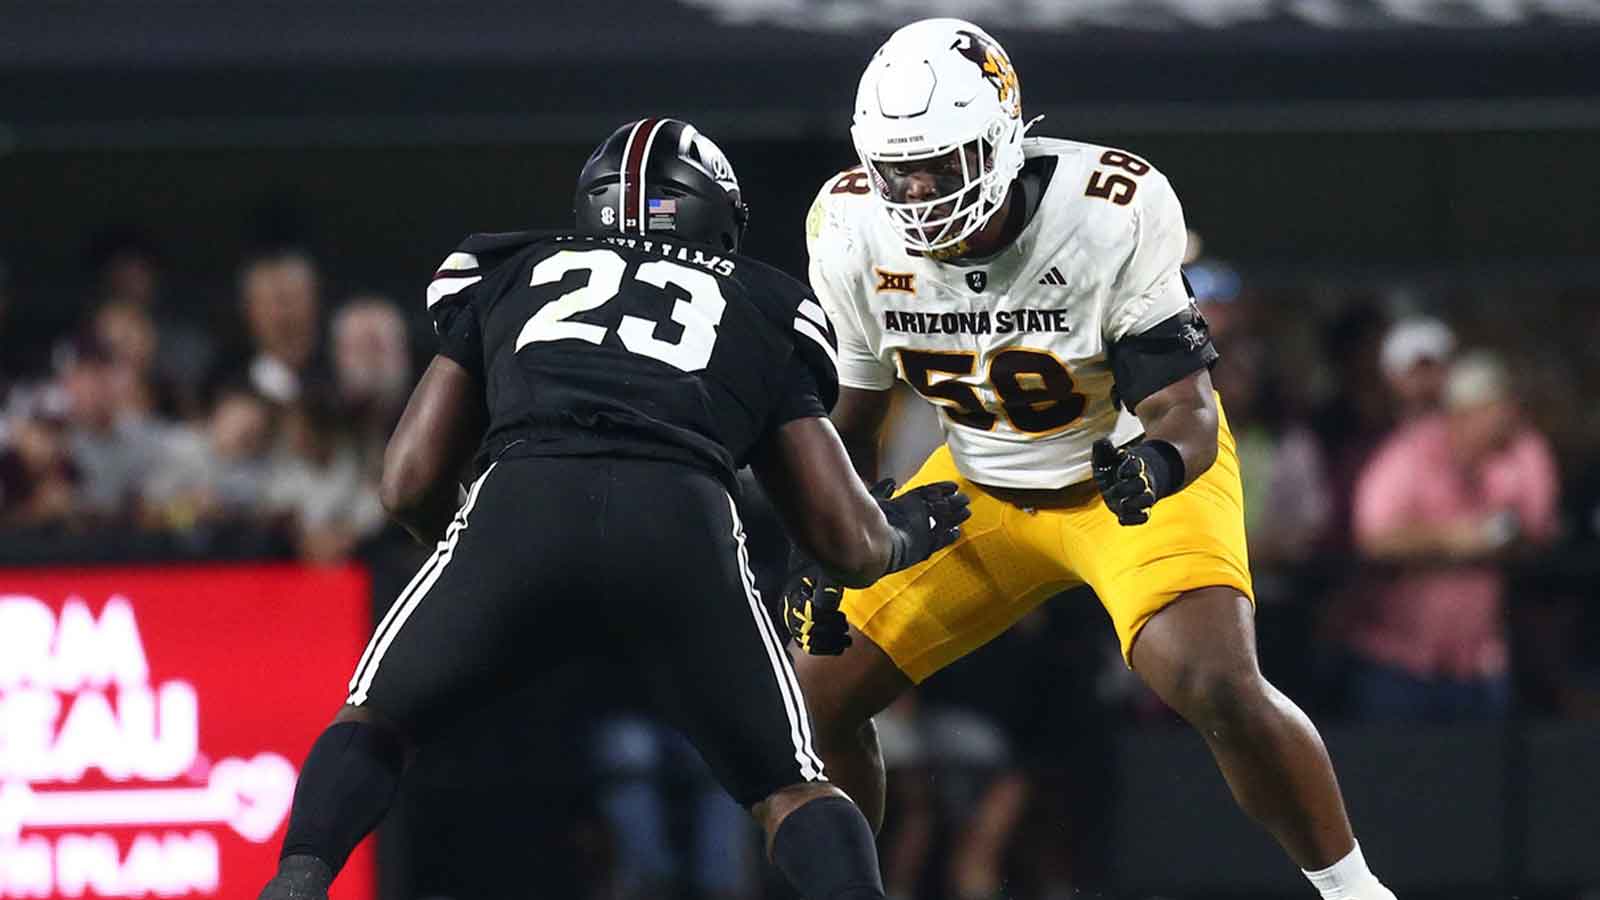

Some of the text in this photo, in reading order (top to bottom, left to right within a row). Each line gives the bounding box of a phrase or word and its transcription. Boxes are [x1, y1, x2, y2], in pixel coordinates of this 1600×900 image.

[1084, 150, 1151, 207] 58
[626, 219, 637, 227] 23
[875, 267, 917, 297] XII
[514, 249, 728, 373] 23
[884, 308, 1070, 335] ARIZONA STATE
[896, 346, 1090, 437] 58
